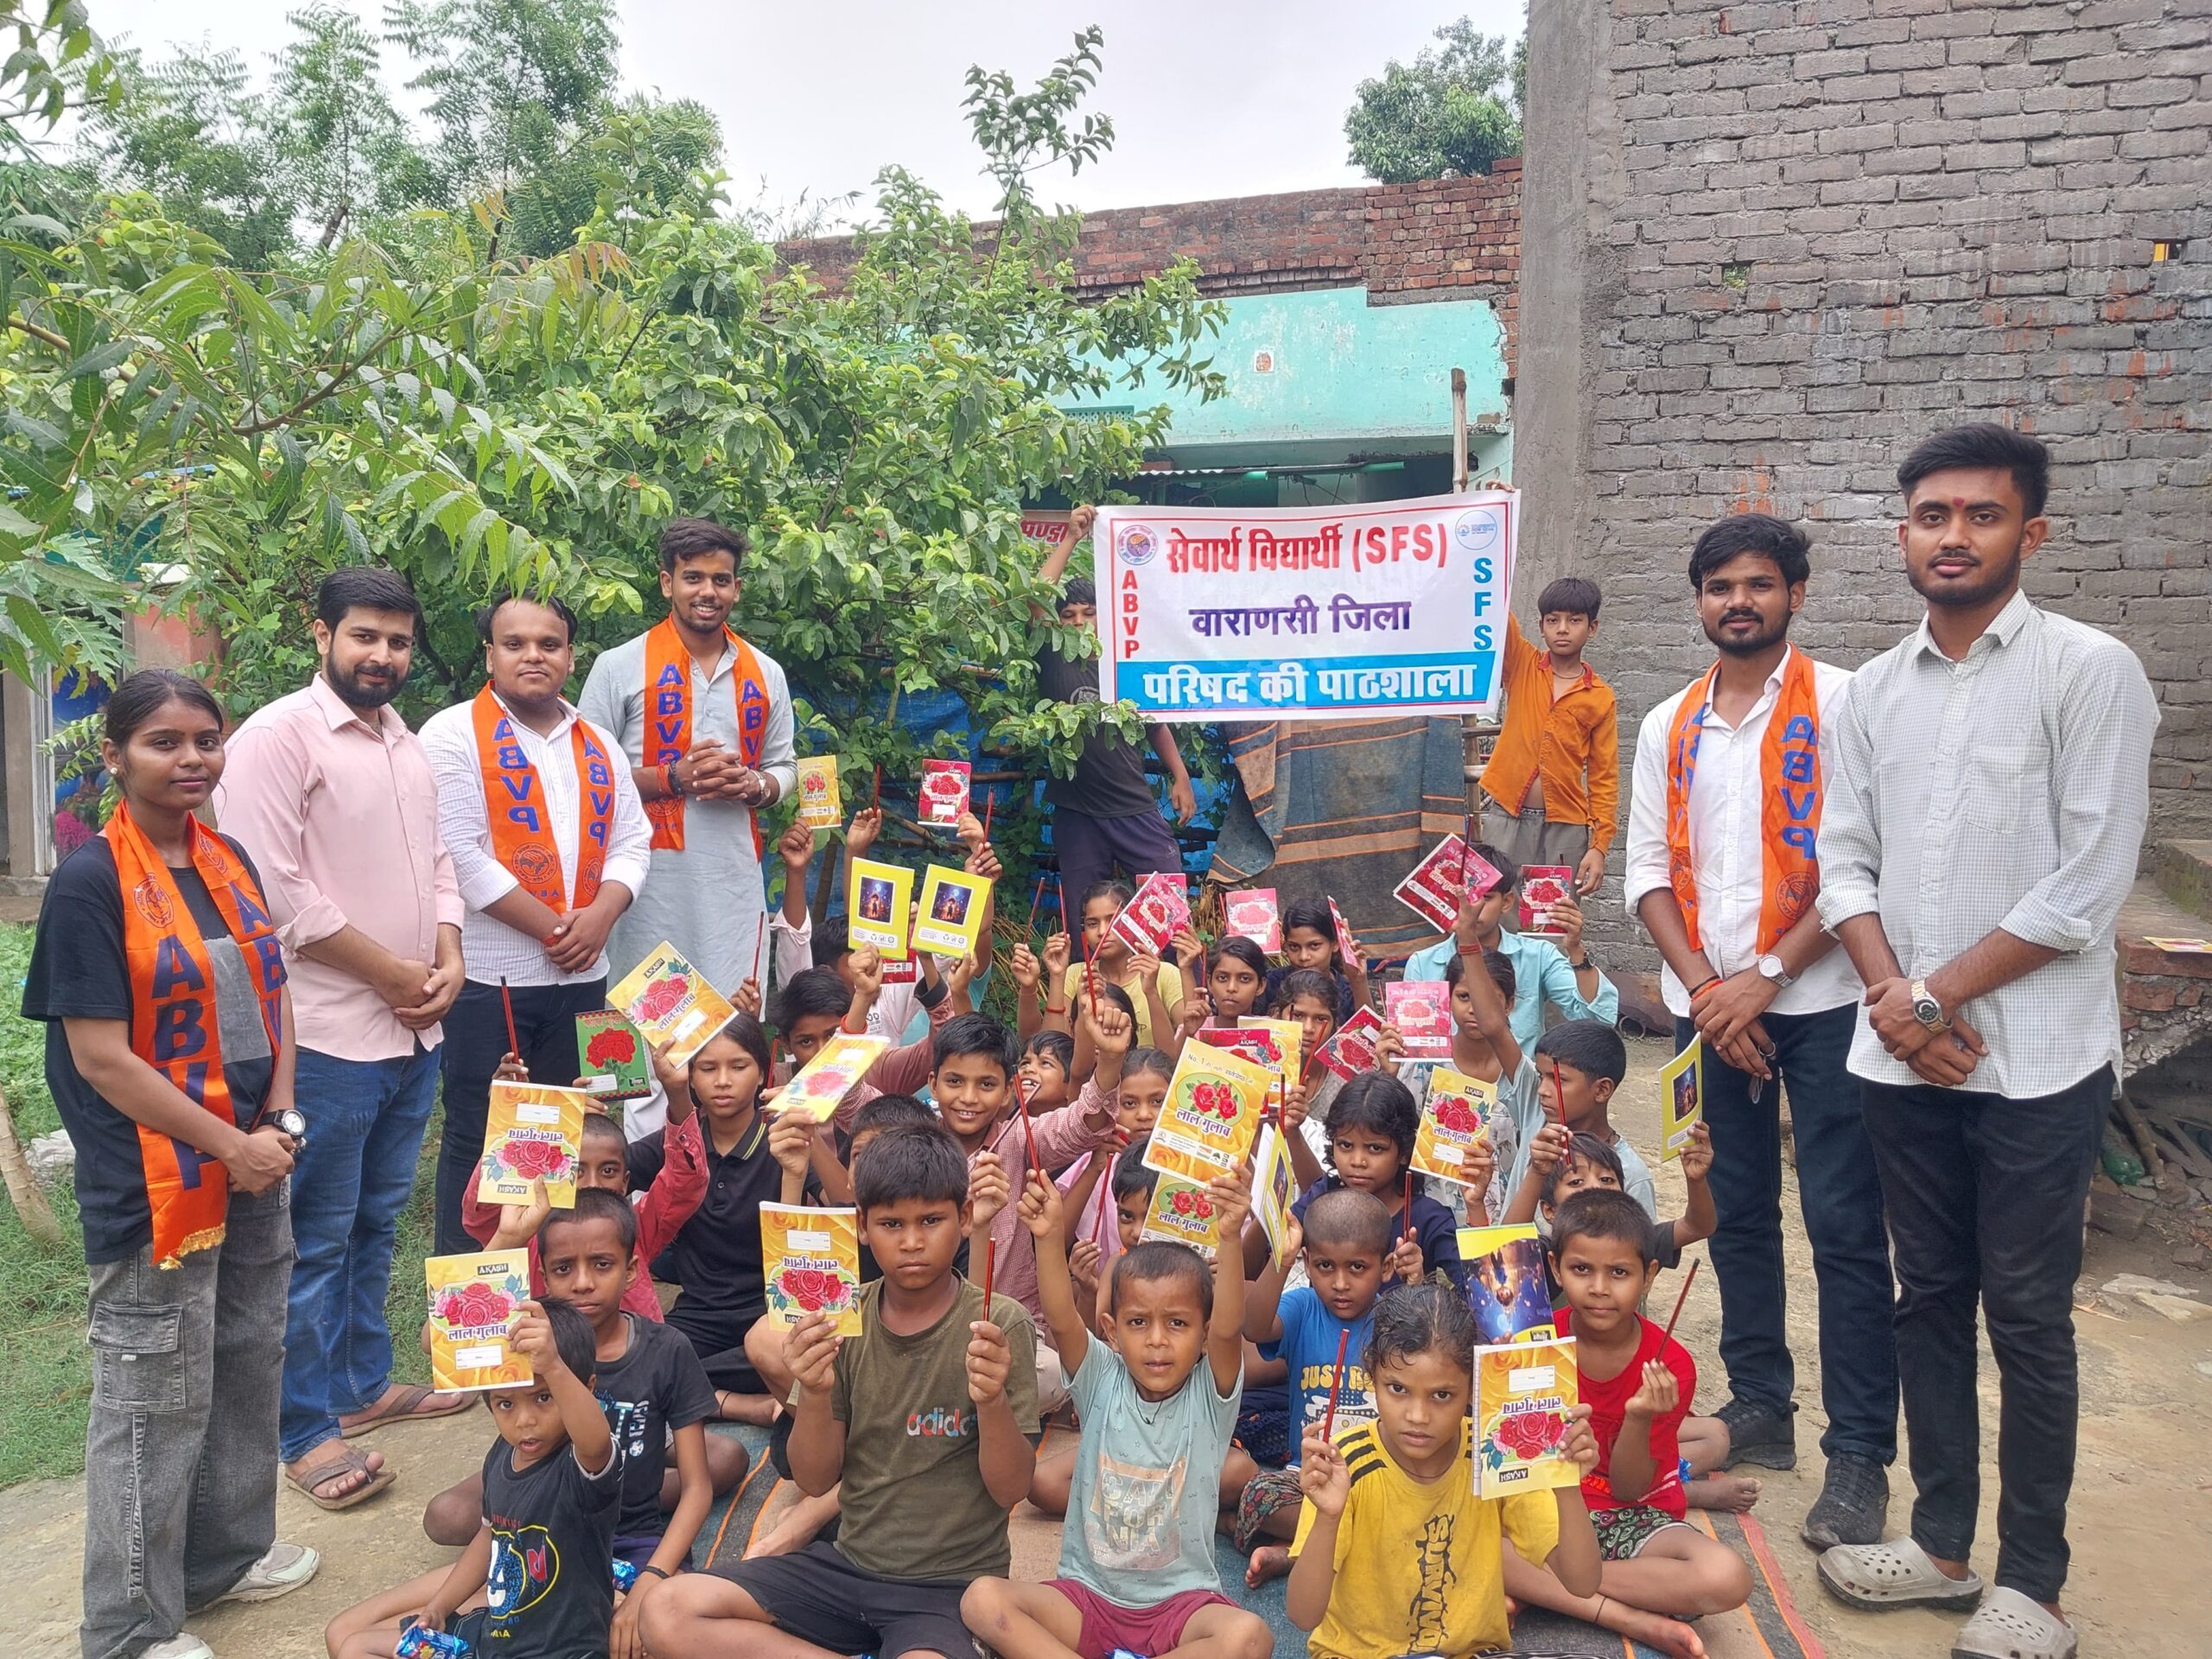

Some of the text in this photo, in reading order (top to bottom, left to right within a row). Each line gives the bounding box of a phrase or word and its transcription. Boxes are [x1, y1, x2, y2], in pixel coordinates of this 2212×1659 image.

[1166, 526, 1242, 573] सेवार्थ
[1249, 523, 1344, 571] विद्यार्थी
[1351, 523, 1447, 573] (SFS)
[1122, 569, 1140, 658] ABVP
[1188, 593, 1412, 637] वाराणसी जिला
[1473, 557, 1492, 651] SFS
[1141, 661, 1478, 705] परिषद की पाठशाला
[1177, 1109, 1231, 1137] लाल गुलाब
[1159, 1211, 1208, 1233] लाल गुलाब
[479, 1265, 507, 1274] AKASH
[448, 1325, 507, 1340] लाल गुलाब
[907, 1407, 972, 1438] adida
[1500, 1469, 1527, 1482] AKASH
